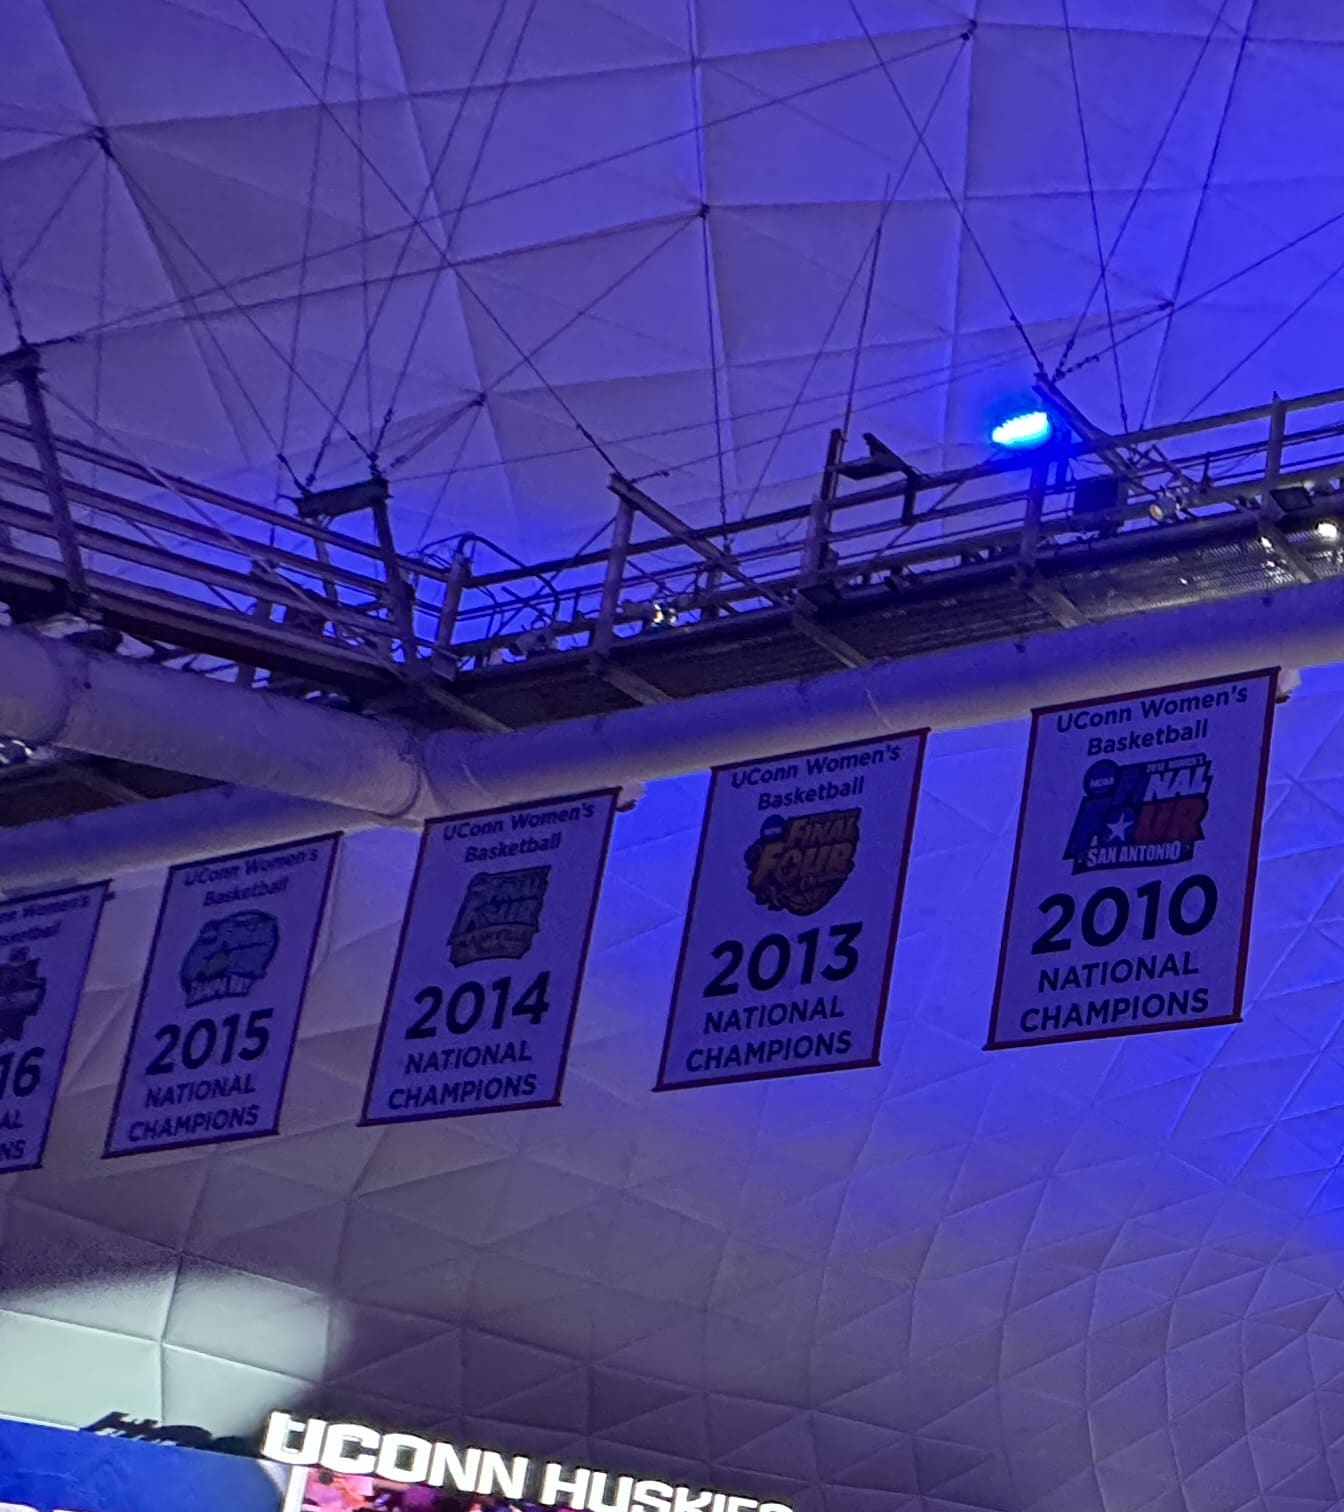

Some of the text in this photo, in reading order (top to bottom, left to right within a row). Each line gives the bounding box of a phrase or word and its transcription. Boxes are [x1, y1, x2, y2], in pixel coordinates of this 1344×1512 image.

[1056, 685, 1249, 733] UConn Women's
[1087, 720, 1208, 756] Basketball
[732, 745, 901, 789] UConn Women's
[758, 777, 865, 811] Basketball
[443, 803, 595, 840] UConn Women's
[787, 815, 860, 846] FINAL
[465, 831, 562, 862] Basketball
[1085, 840, 1181, 867] SAN ANTONIO
[1031, 874, 1218, 955] 2010
[703, 921, 863, 999] 2013
[1038, 951, 1199, 993] NATIONAL
[405, 970, 551, 1040] 2014
[703, 995, 844, 1035] NATIONAL
[1020, 988, 1209, 1033] CHAMPIONS
[145, 1007, 273, 1076] 2015
[403, 1040, 532, 1075] NATIONAL
[686, 1031, 853, 1073] CHAMPIONS
[144, 1073, 257, 1108] NATIONAL
[387, 1074, 537, 1110] CHAMPIONS
[127, 1104, 259, 1142] CHAMPIONS
[263, 1410, 529, 1500] UCONN
